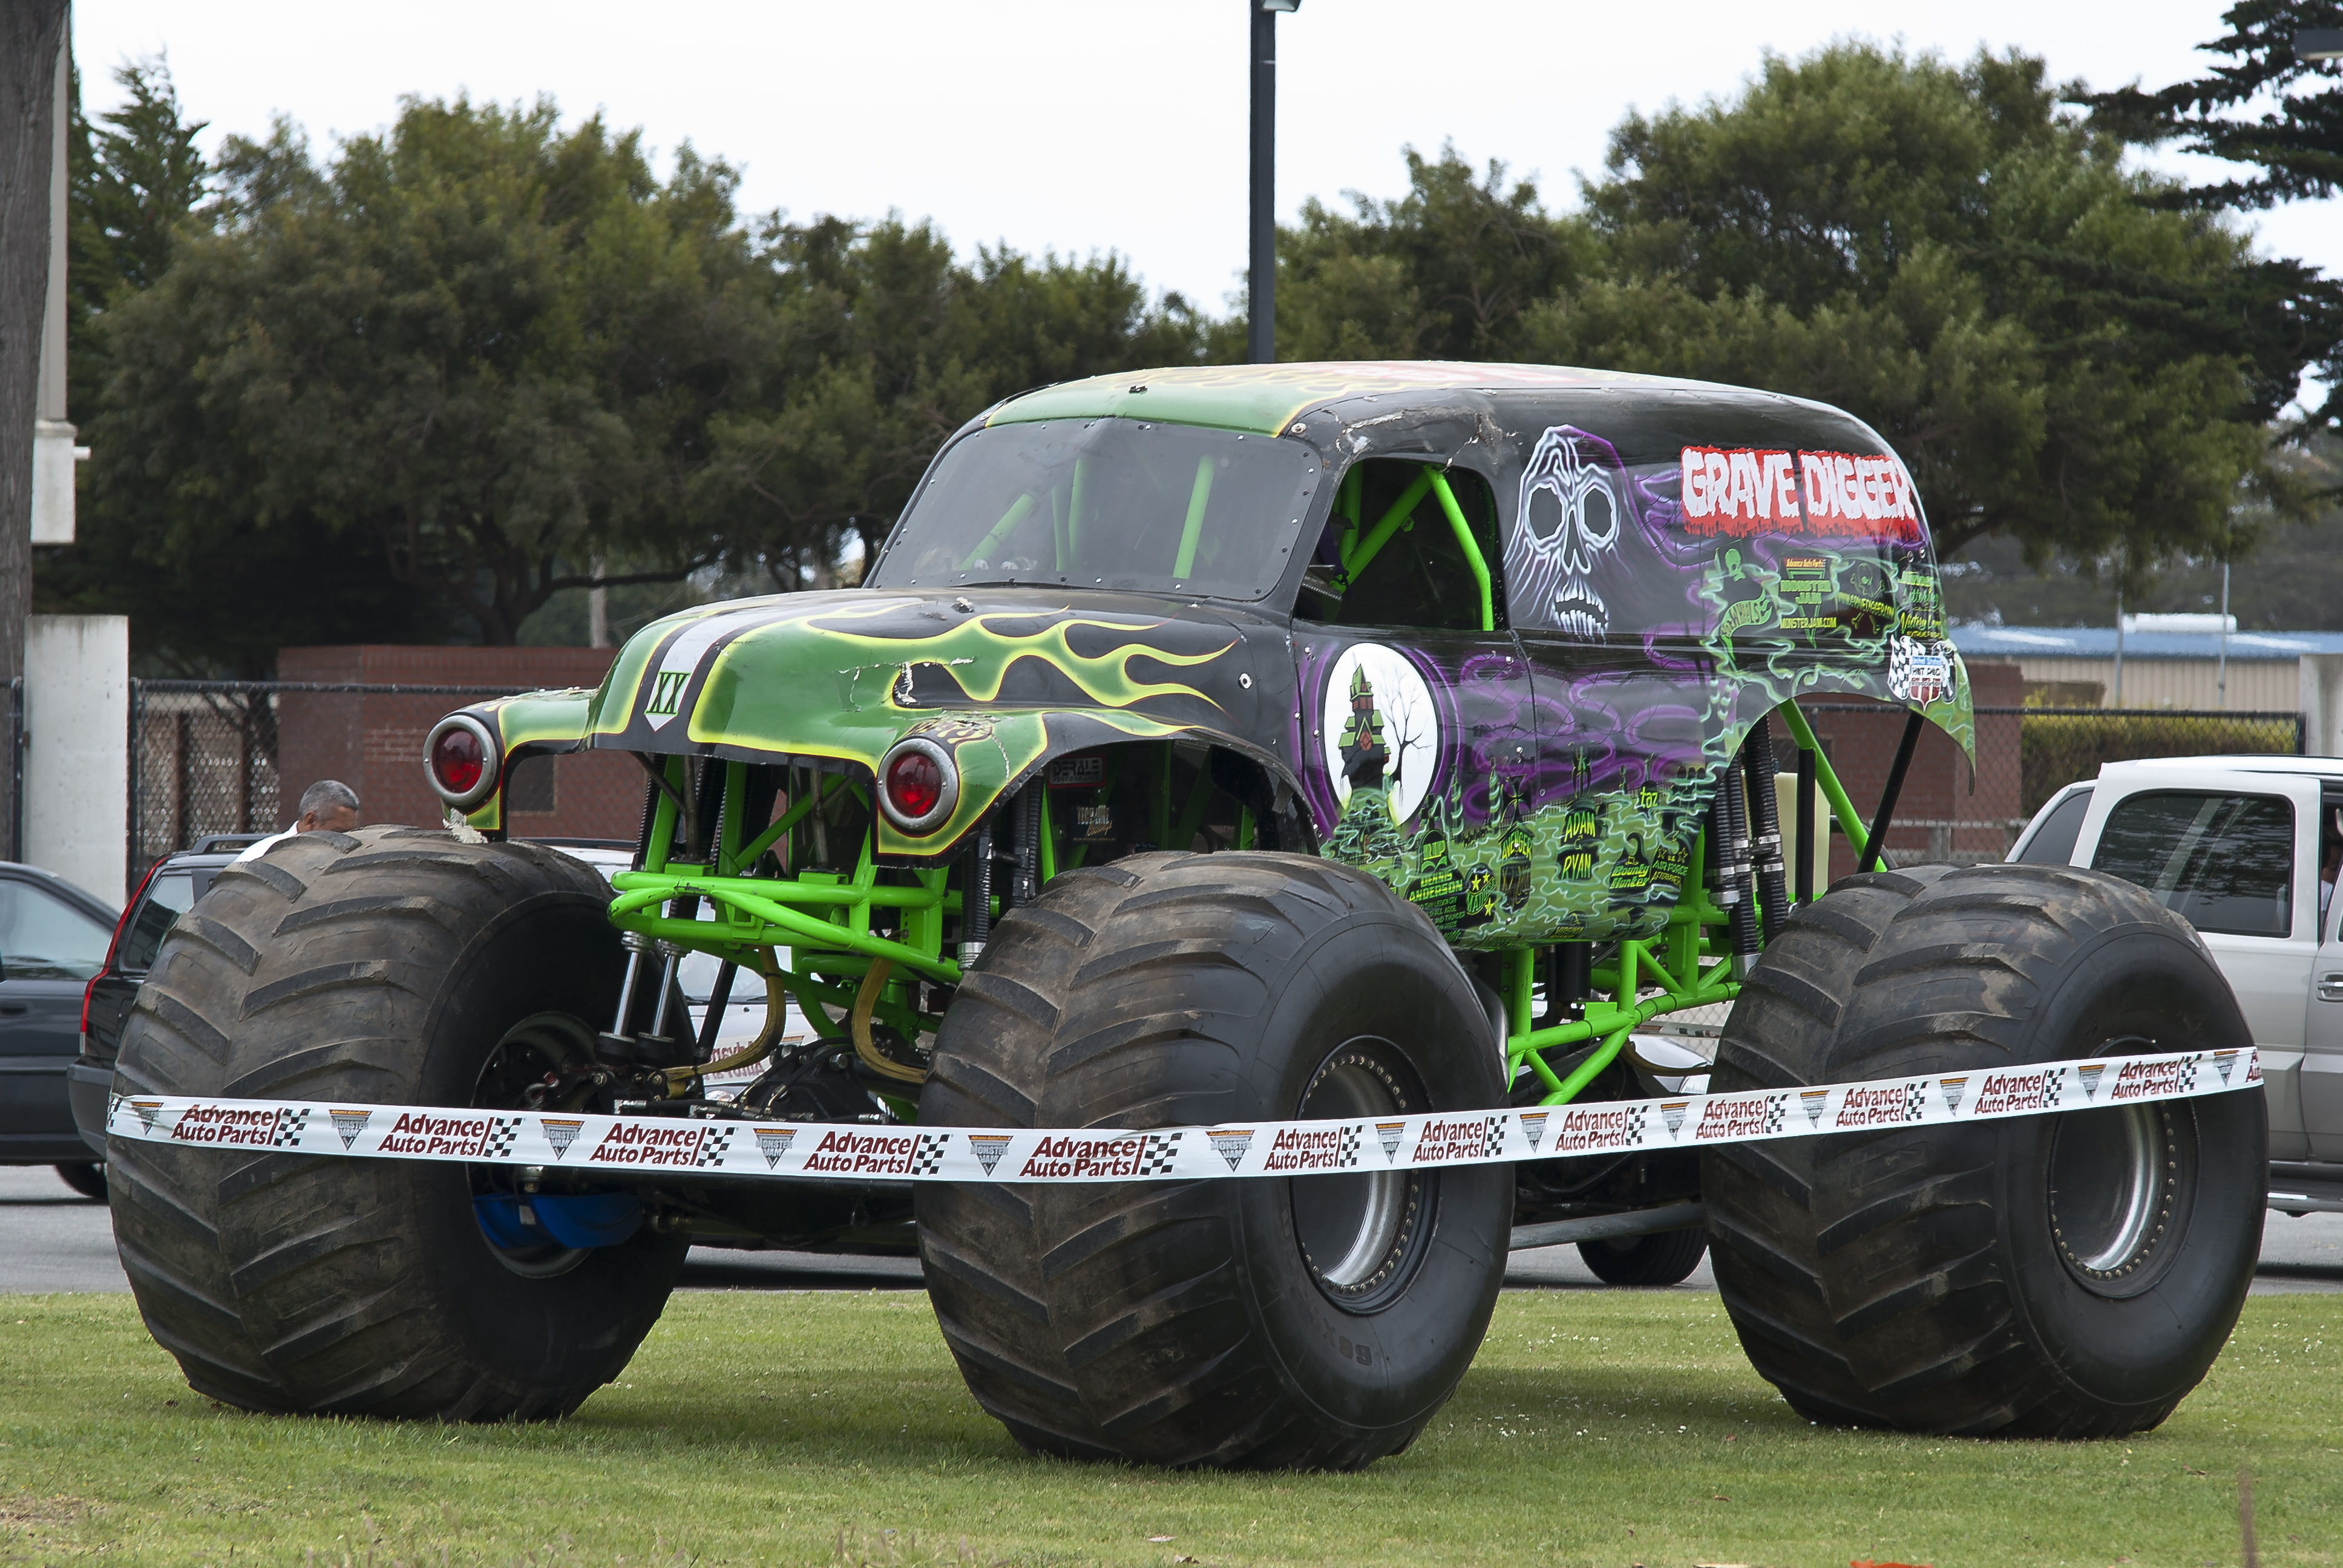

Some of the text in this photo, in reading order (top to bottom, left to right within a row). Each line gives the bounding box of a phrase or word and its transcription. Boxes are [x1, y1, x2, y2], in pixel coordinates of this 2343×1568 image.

[1682, 448, 1916, 520] GRAVE DIGGER
[1795, 592, 1822, 604] JAM
[1780, 617, 1837, 629] MONSTERJAM.COM
[644, 671, 691, 715] XX
[1053, 759, 1099, 776] DERALE
[1640, 786, 1659, 808] taz
[1564, 811, 1596, 842] ADAM
[1502, 830, 1532, 861] AVENGER
[1562, 854, 1591, 881] RYAN
[1611, 864, 1650, 877] Bounty
[1653, 860, 1689, 876] AIR FORCE
[1409, 879, 1463, 901] ANDERSON
[1610, 877, 1650, 889] Hunter
[2119, 1060, 2177, 1081] Advance
[1981, 1074, 2040, 1096] Advance
[2111, 1082, 2140, 1100] Auto
[2142, 1077, 2174, 1096] Parts
[1843, 1087, 1902, 1109] Advance
[1974, 1093, 2036, 1114] Auto Parts
[180, 1104, 272, 1126] Advance
[1562, 1109, 1622, 1132] Advance
[1703, 1099, 1762, 1121] Advance
[1836, 1106, 1899, 1126] Auto Parts
[171, 1122, 267, 1145] Auto Parts
[391, 1113, 485, 1137] Advance
[603, 1123, 696, 1146] Advance
[1420, 1120, 1482, 1142] Advance
[1696, 1118, 1759, 1139] Auto Parts
[377, 1135, 478, 1156] Auto Parts
[816, 1131, 910, 1155] Advance
[1031, 1135, 1137, 1158] Advance
[1272, 1129, 1337, 1150] Advance
[1555, 1129, 1619, 1151] Auto Parts
[589, 1145, 691, 1165] Auto Parts
[1263, 1151, 1333, 1170] Auto Parts
[1412, 1140, 1479, 1162] Auto Parts
[802, 1154, 905, 1174] Auto Parts
[1019, 1158, 1130, 1177] Auto Parts
